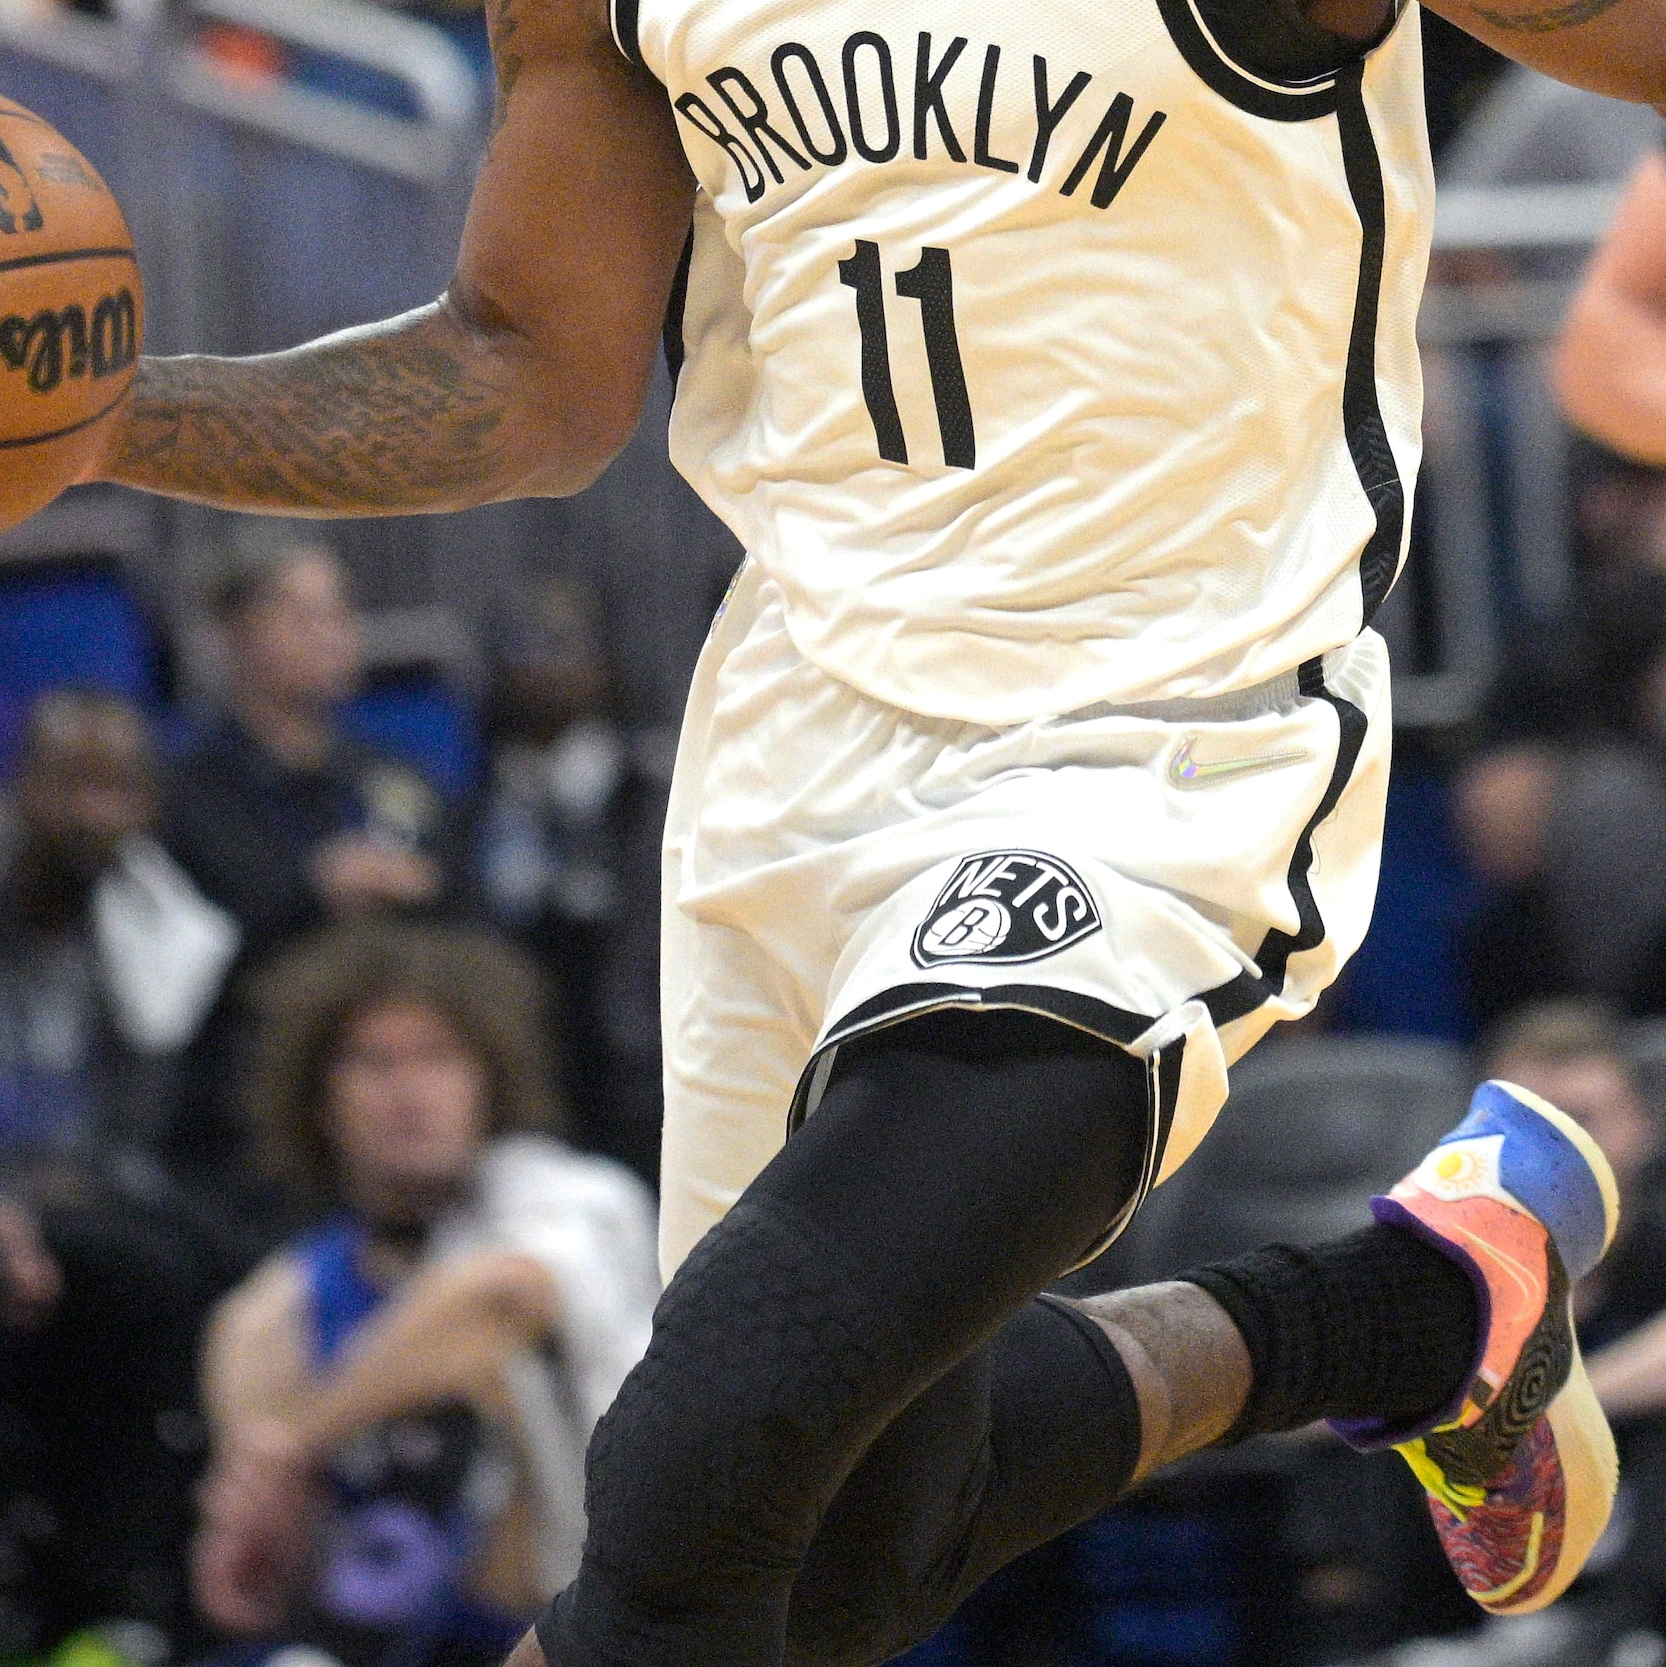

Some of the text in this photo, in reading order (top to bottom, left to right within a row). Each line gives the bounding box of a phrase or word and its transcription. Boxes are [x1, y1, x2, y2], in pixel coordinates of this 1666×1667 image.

[674, 31, 1166, 210] BROOKLYN
[838, 239, 976, 470] 11
[938, 855, 1087, 942] NETS
